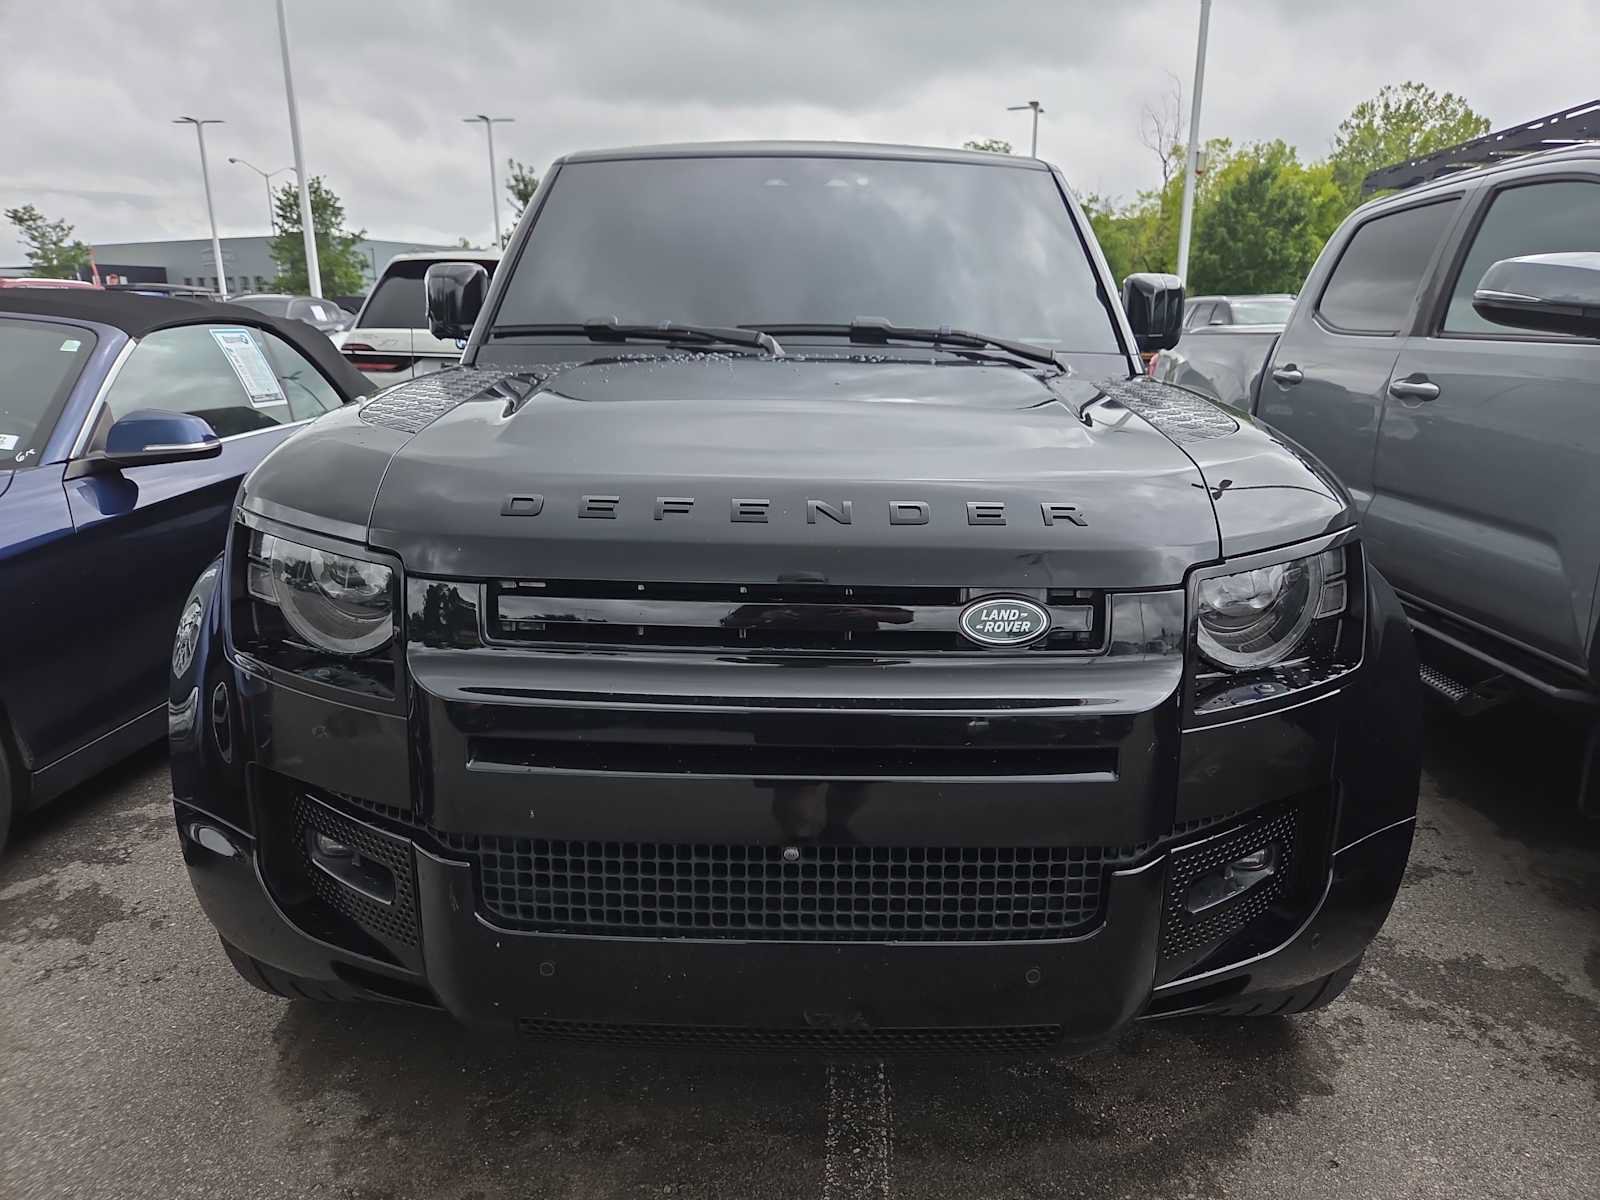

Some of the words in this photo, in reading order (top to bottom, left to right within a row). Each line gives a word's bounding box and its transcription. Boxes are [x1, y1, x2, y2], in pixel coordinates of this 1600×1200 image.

[500, 493, 1089, 527] DEFENDER
[980, 609, 1020, 621] LAND
[983, 621, 1031, 633] ROVER
